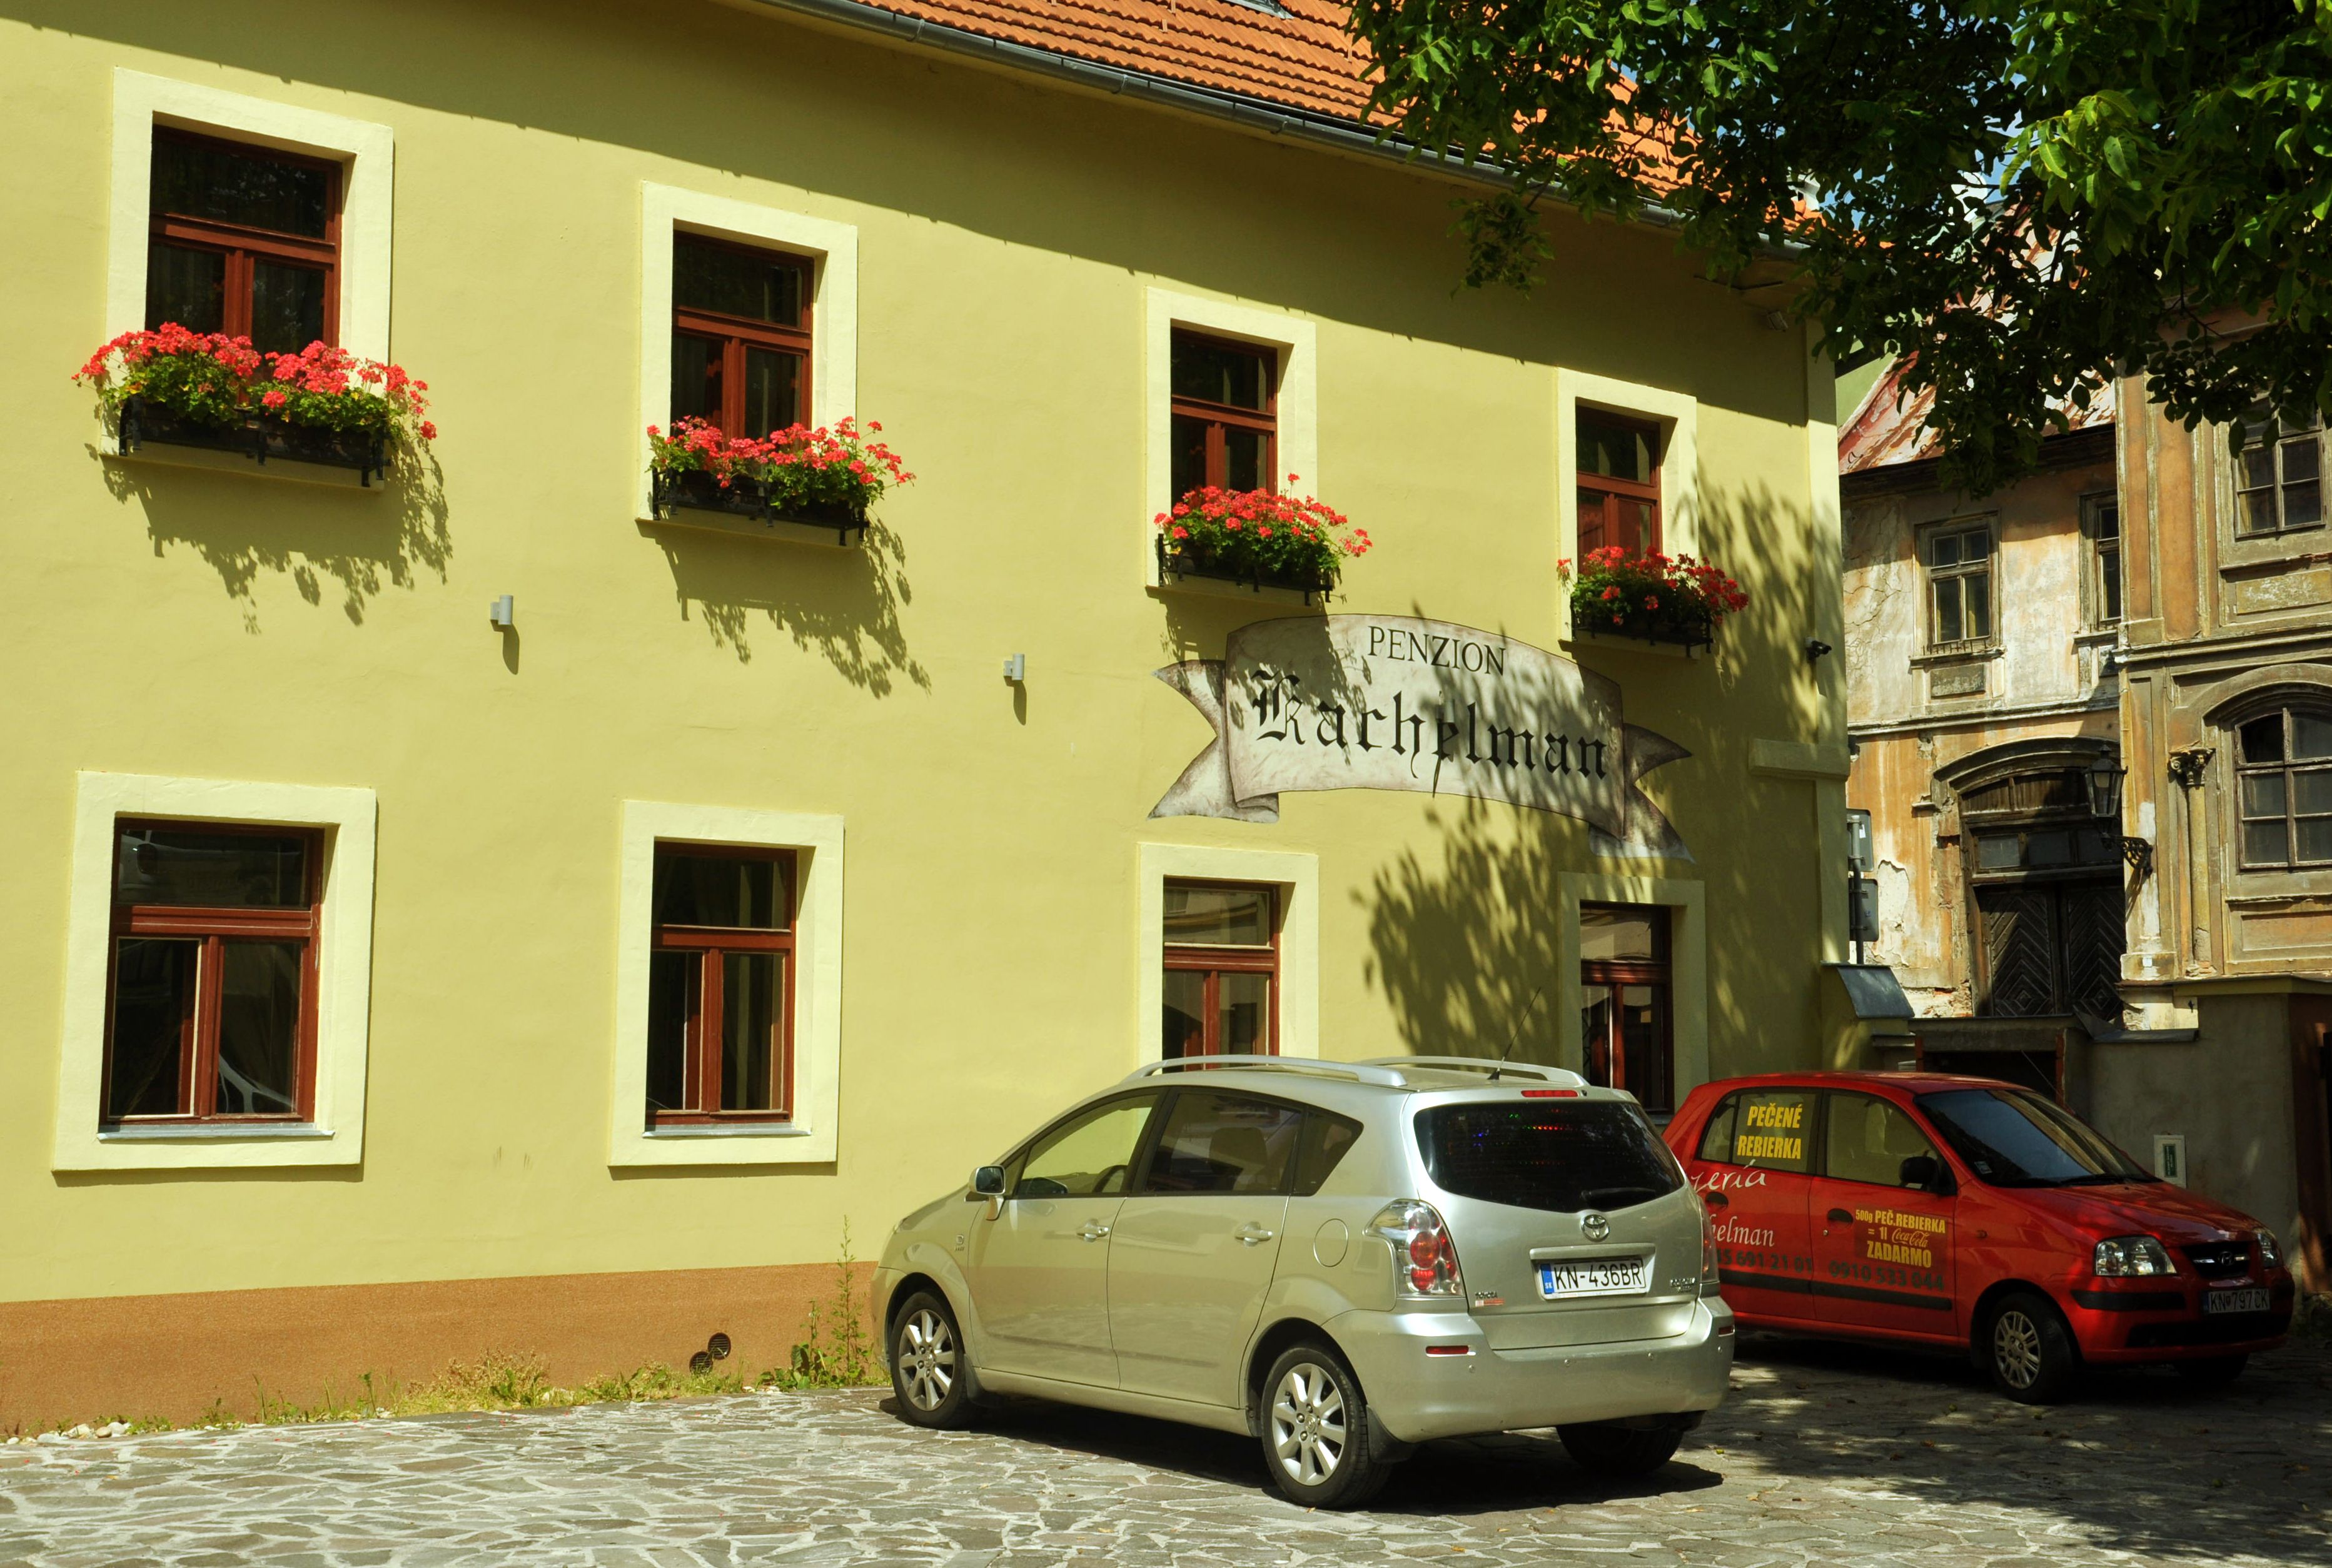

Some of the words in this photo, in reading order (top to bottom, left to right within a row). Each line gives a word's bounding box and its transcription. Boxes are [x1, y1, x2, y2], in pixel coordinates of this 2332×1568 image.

[1368, 625, 1506, 676] PENZION
[1250, 670, 1607, 780] Kachelman
[1747, 1103, 1802, 1128] PEČENÉ
[1737, 1135, 1801, 1159] REBIERKA
[1855, 1210, 1873, 1224] 500g
[1867, 1240, 1932, 1268] ZADARMO
[1554, 1263, 1642, 1290] KN-436BR
